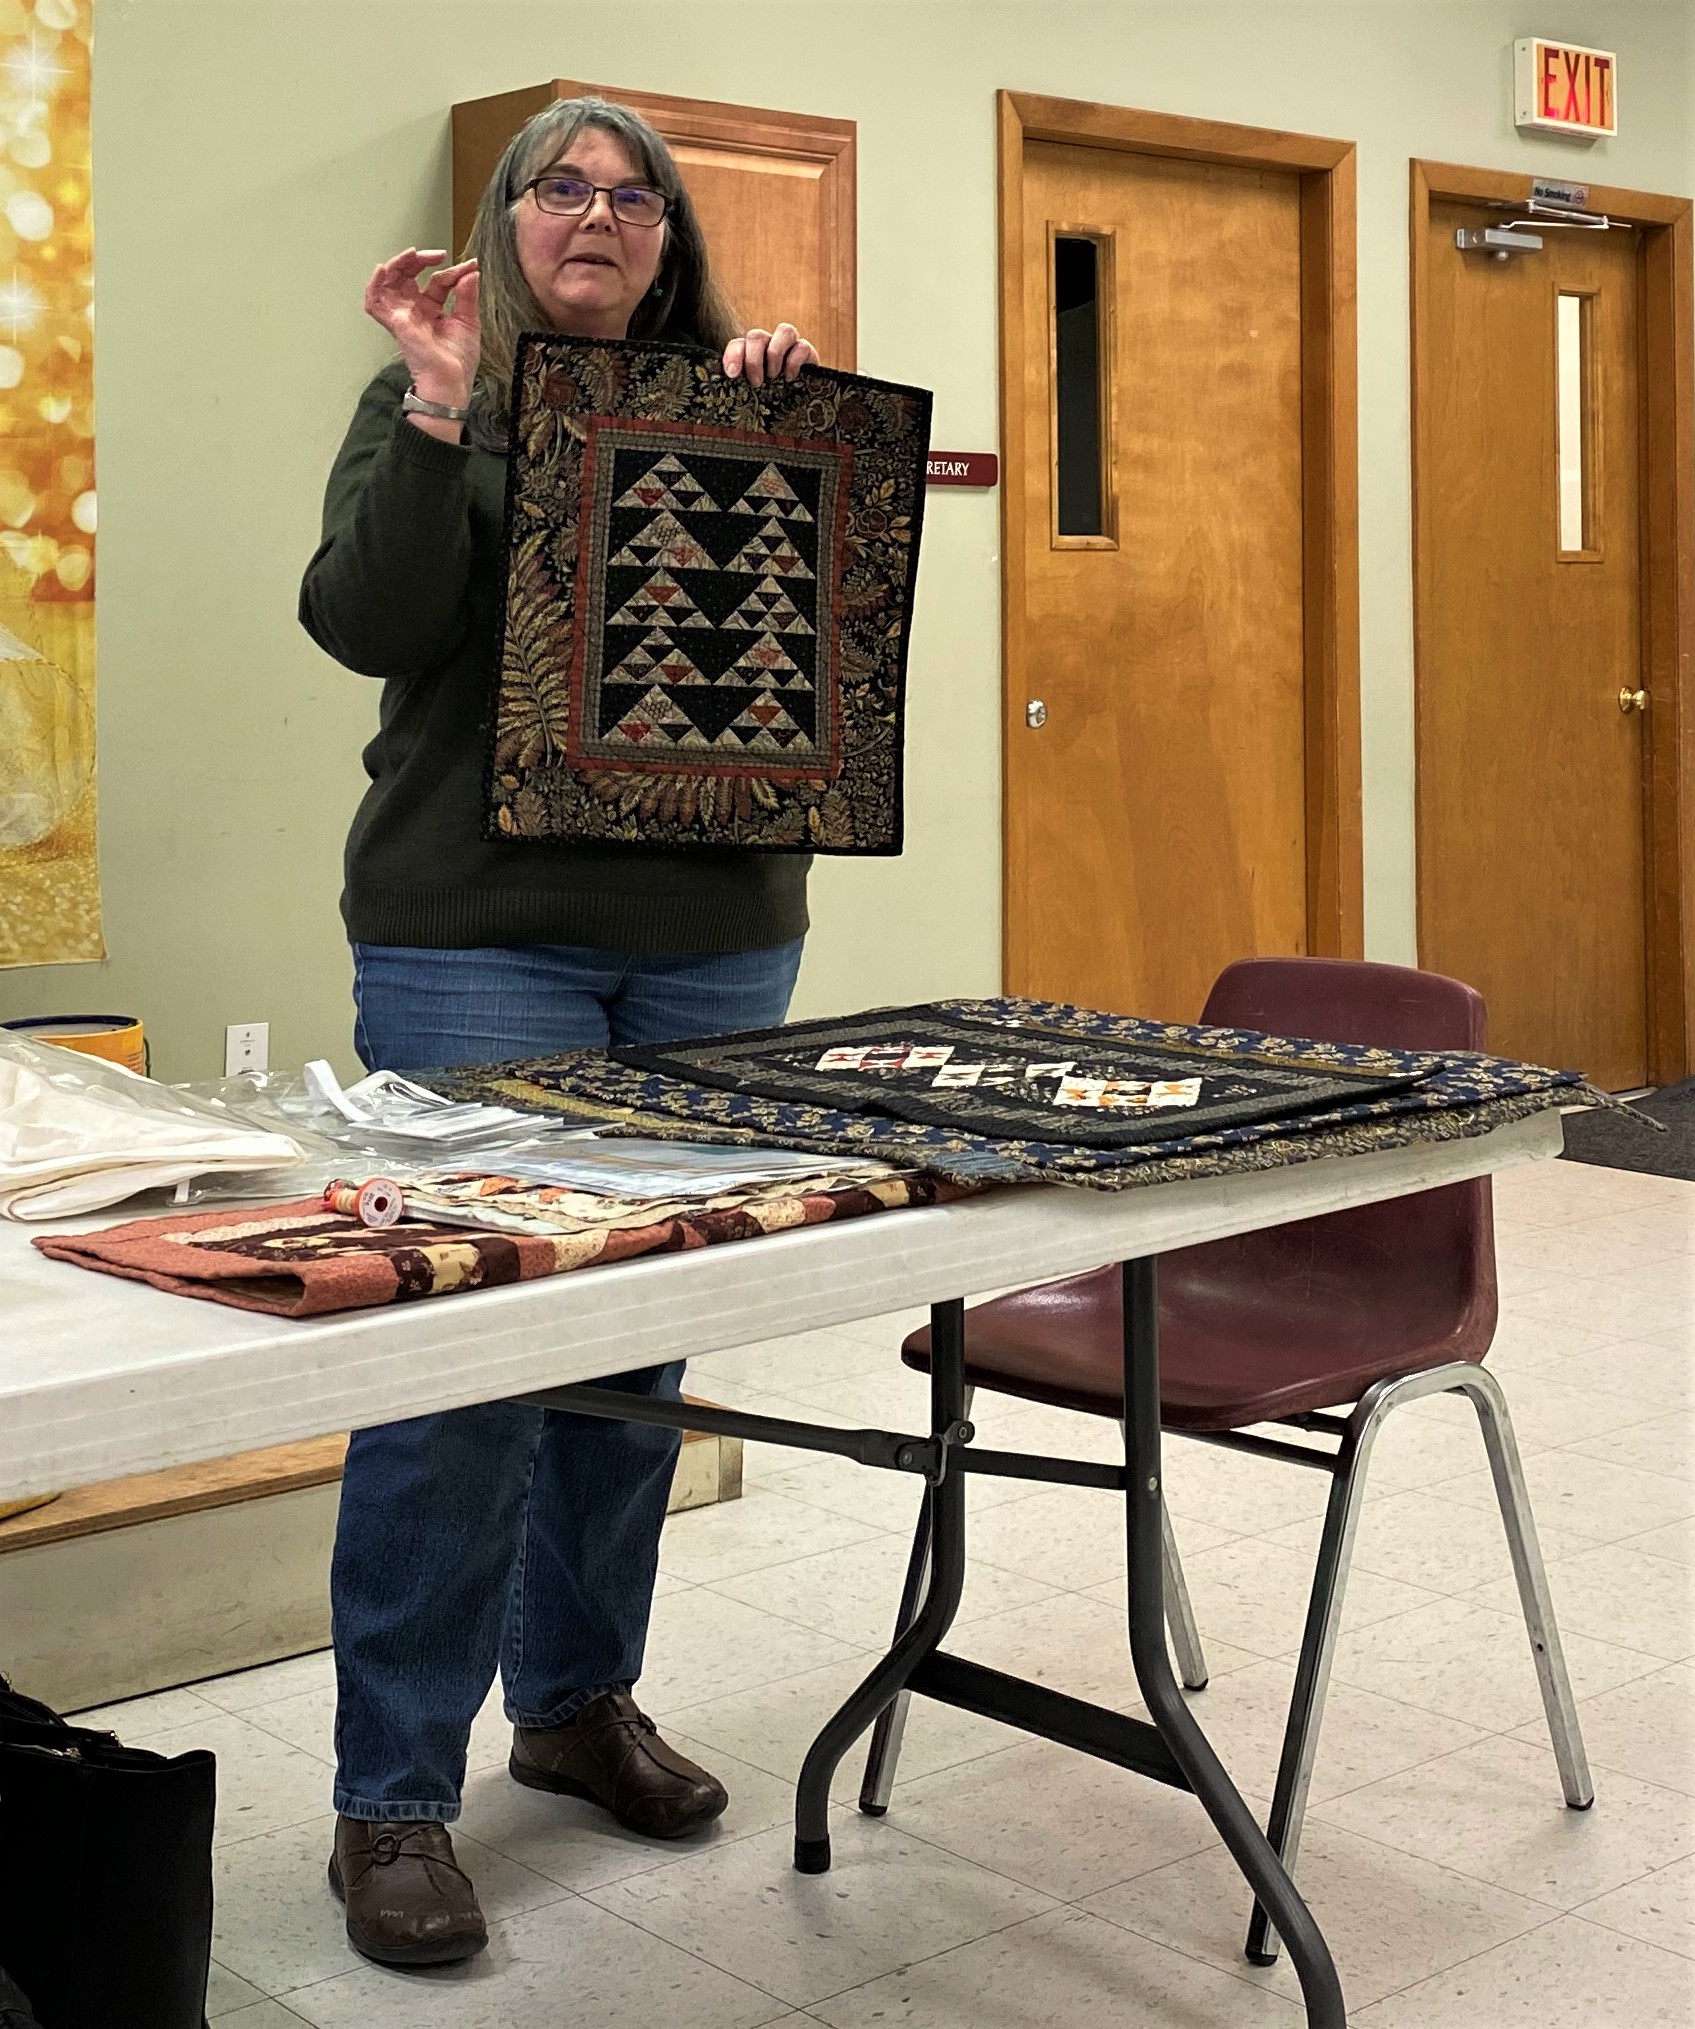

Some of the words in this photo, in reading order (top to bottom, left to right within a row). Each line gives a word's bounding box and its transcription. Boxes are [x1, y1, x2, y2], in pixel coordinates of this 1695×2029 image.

[1544, 47, 1610, 126] EXIT
[1534, 187, 1544, 197] No
[1544, 187, 1572, 202] Smoking
